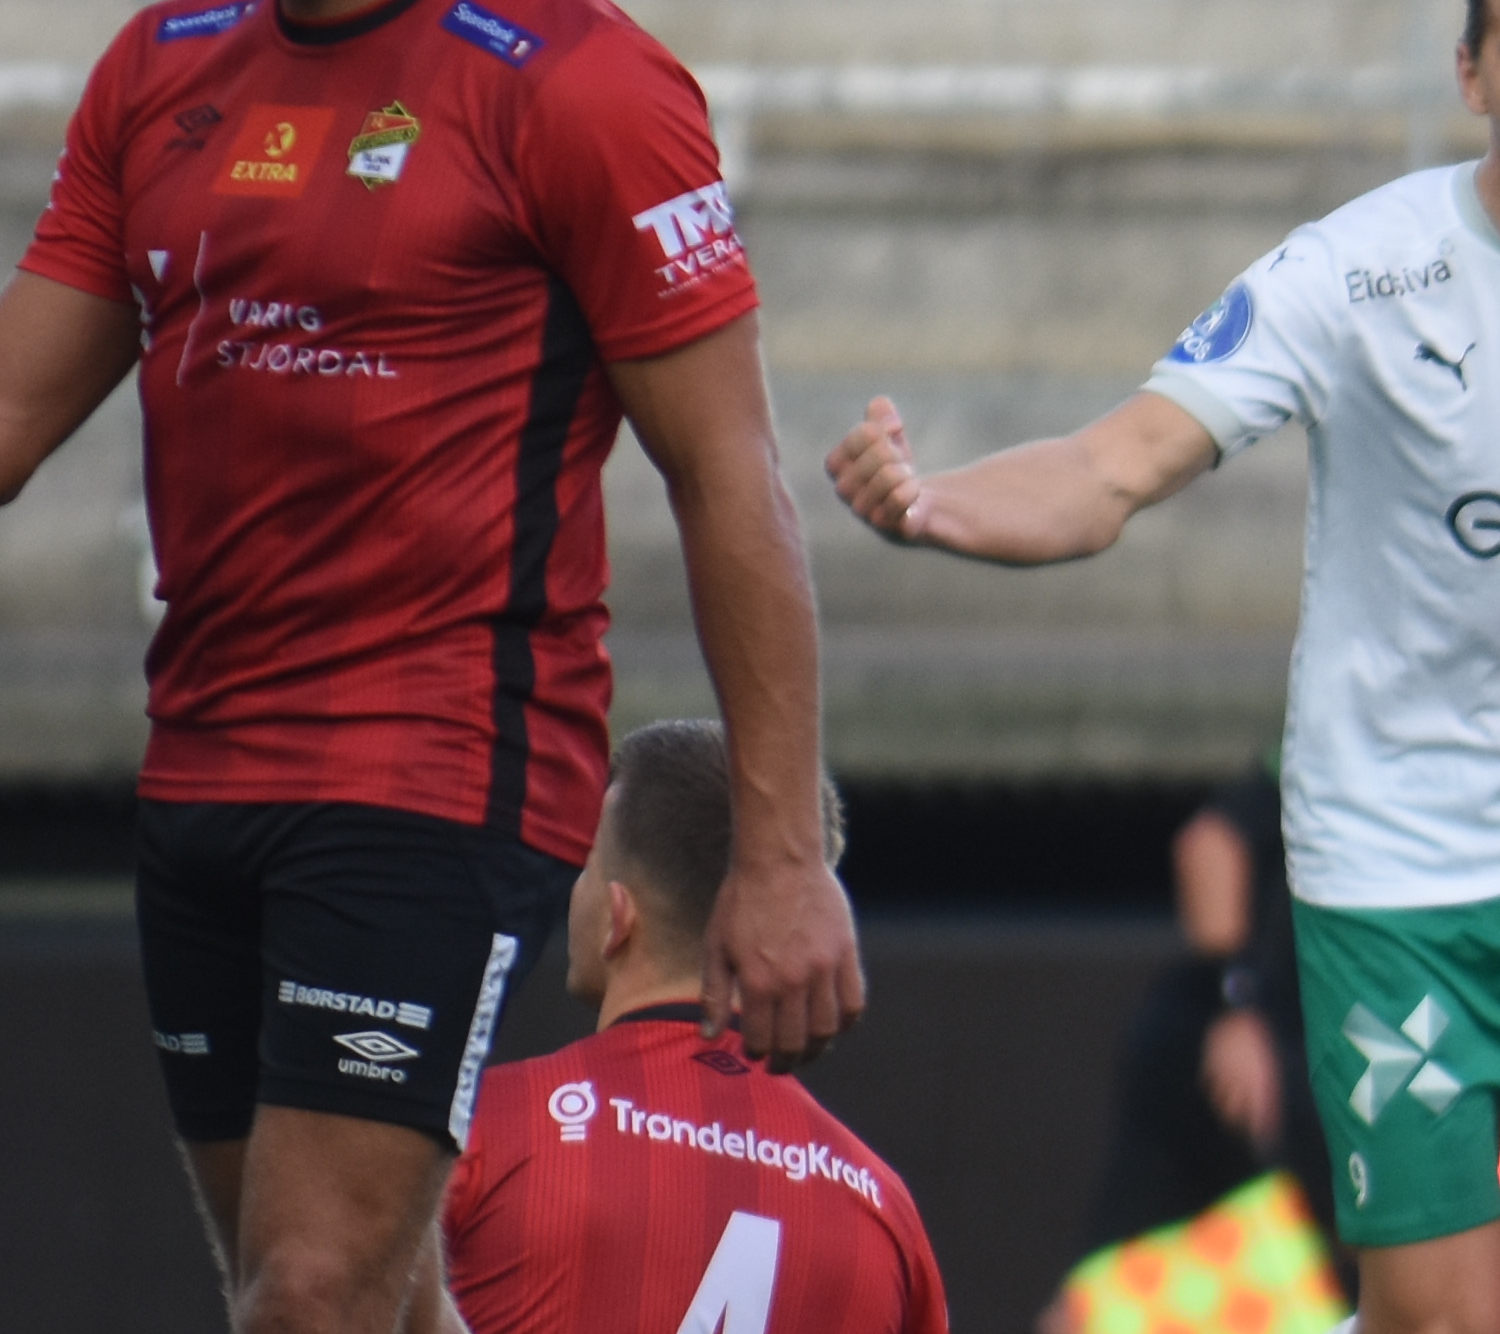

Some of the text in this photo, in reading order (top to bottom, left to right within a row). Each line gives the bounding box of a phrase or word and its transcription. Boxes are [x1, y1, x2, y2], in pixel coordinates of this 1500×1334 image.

[231, 161, 297, 183] EXTRA
[229, 299, 321, 332] VARIG
[217, 340, 396, 378] STJØRDAL
[295, 985, 397, 1019] BØRSTAD
[337, 1058, 405, 1084] umbro
[609, 1097, 882, 1209] TrøndelagKraft
[1349, 1151, 1370, 1209] 9
